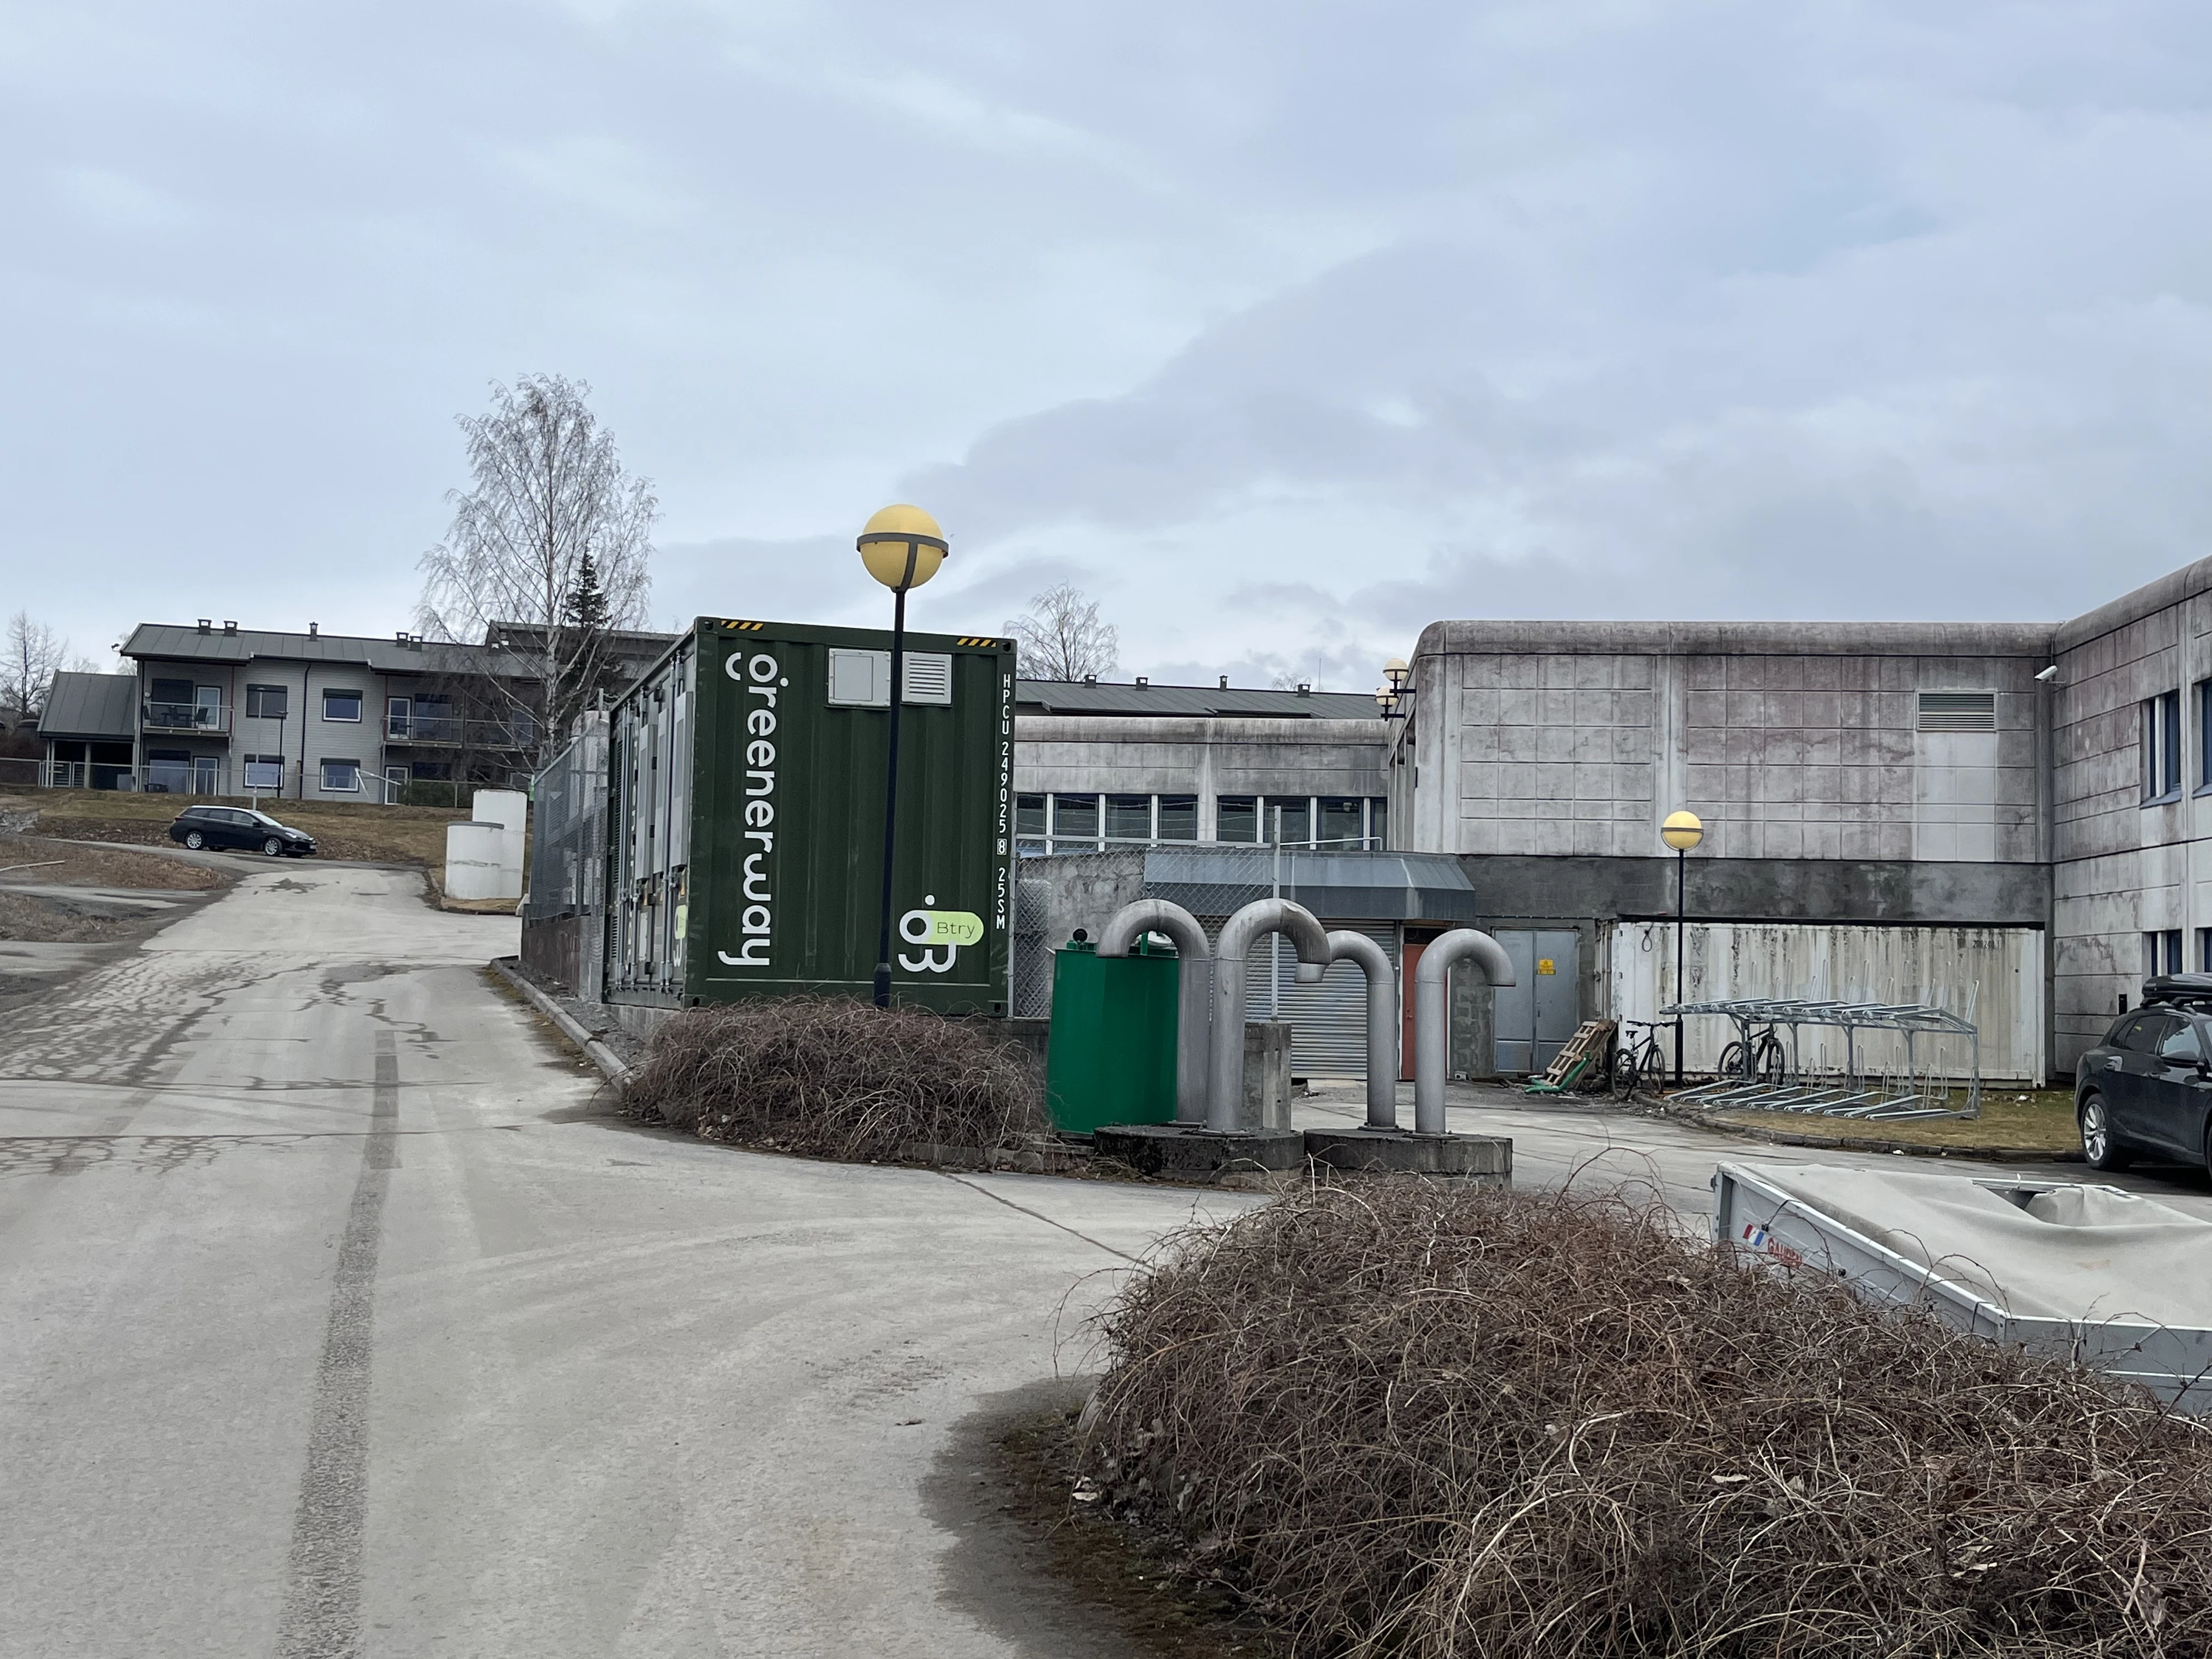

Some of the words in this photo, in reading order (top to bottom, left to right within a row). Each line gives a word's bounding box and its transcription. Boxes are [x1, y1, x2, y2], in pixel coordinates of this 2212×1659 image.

[1001, 673, 1011, 735] HPCU
[998, 741, 1009, 834] 249025
[997, 839, 1007, 855] 8
[937, 922, 975, 939] Btry
